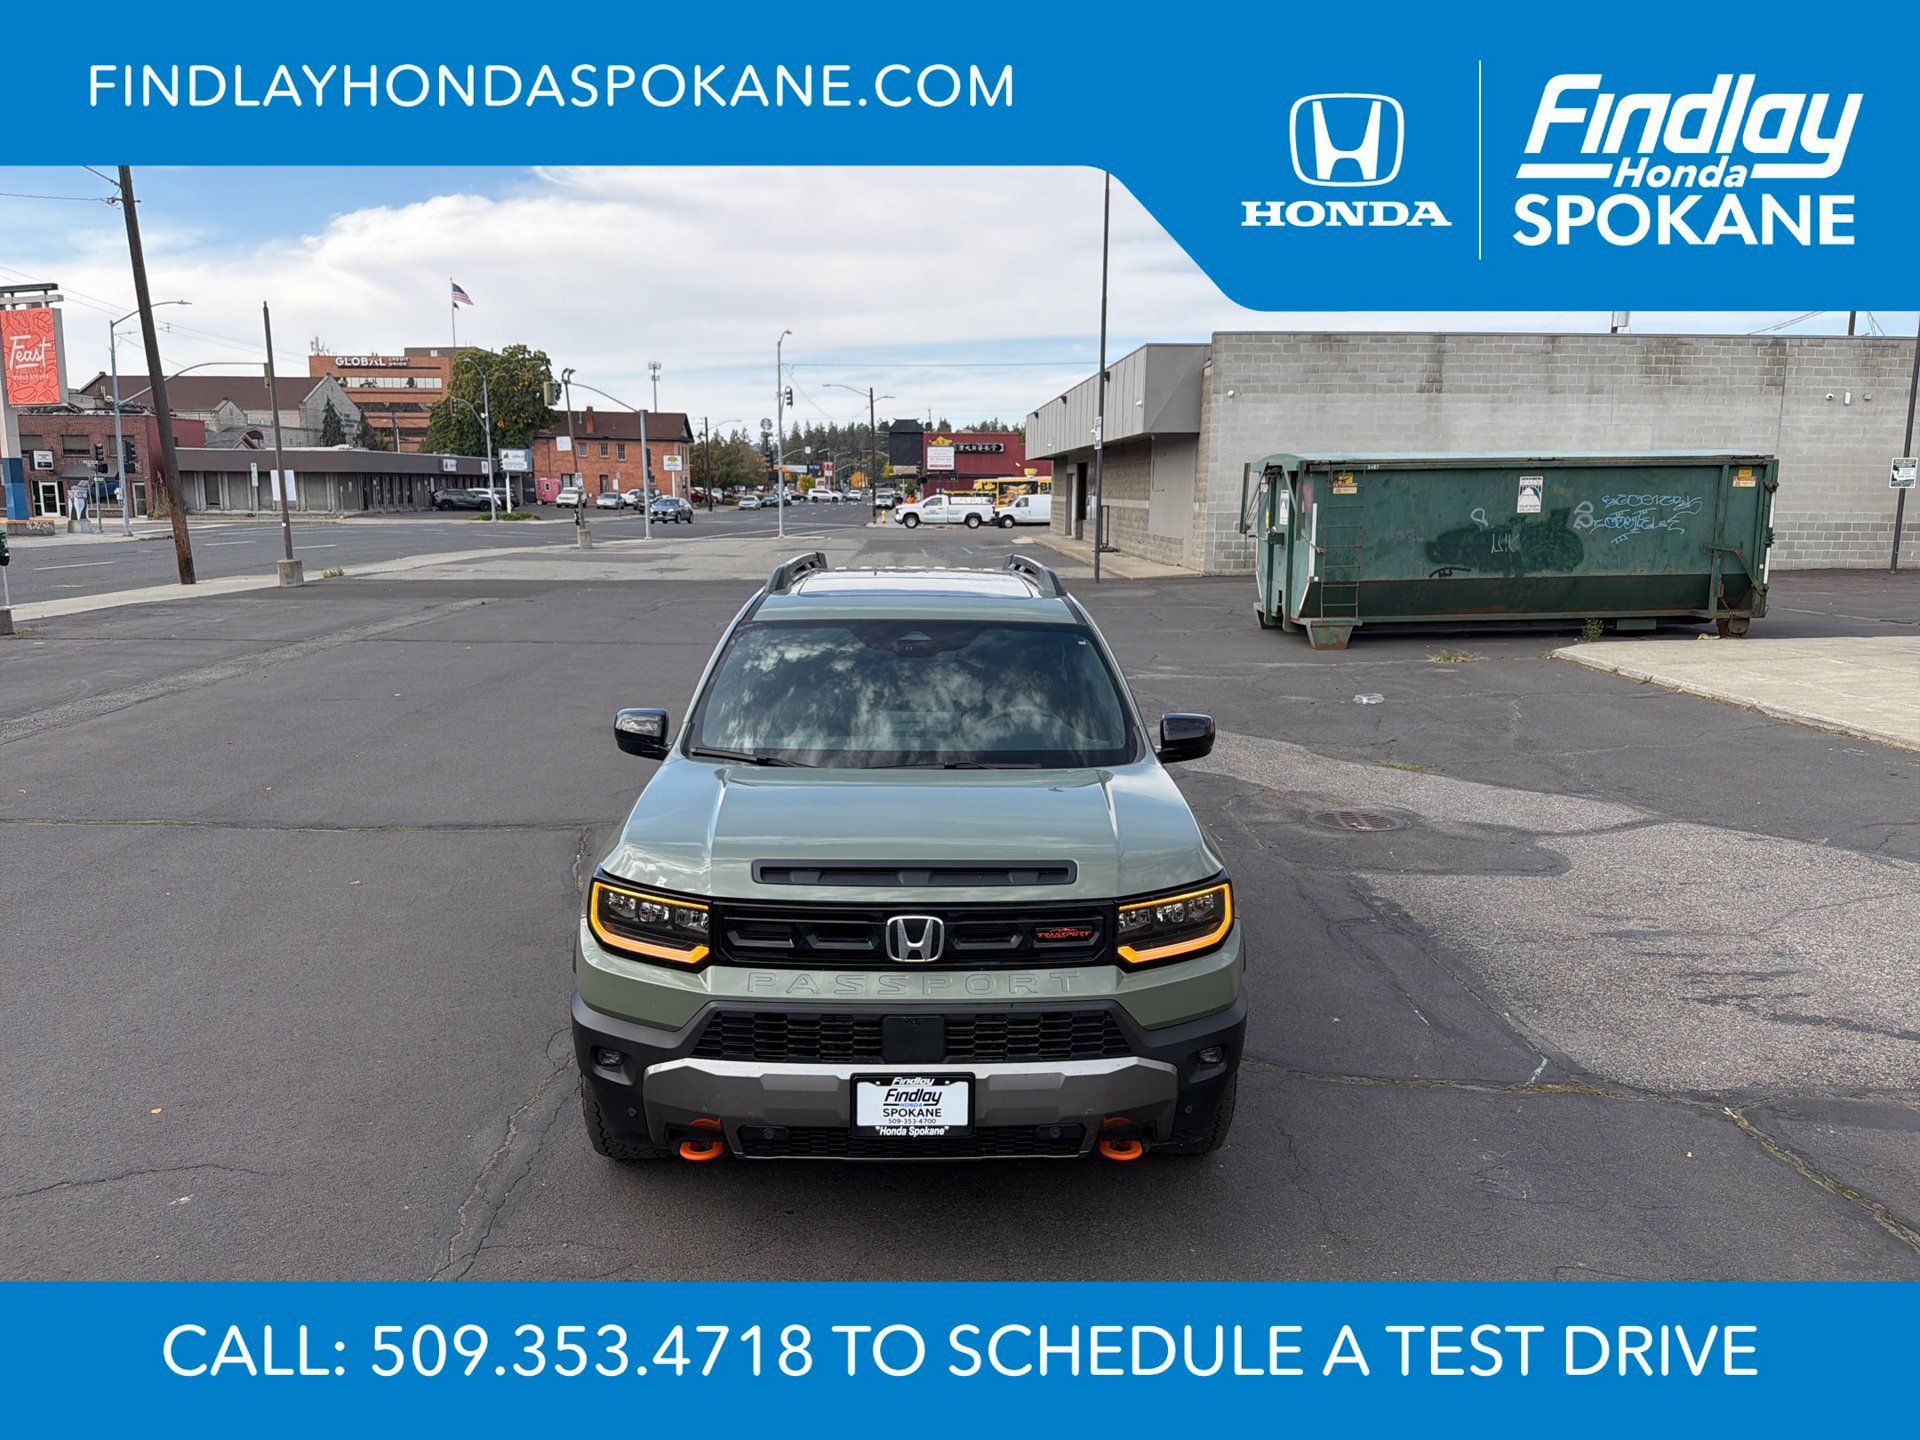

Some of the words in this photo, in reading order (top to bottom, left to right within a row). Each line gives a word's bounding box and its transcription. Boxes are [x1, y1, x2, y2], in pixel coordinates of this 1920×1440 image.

[9, 334, 52, 369] Feast
[335, 357, 387, 366] GLOBAL
[1036, 931, 1092, 939] TRAILSPORT
[747, 971, 1080, 996] PASSPORT
[892, 1076, 935, 1086] Findlay
[883, 1088, 943, 1106] Findlay
[883, 1108, 942, 1118] SPOKANE
[879, 1126, 907, 1136] Honda
[908, 1126, 945, 1138] Spokane
